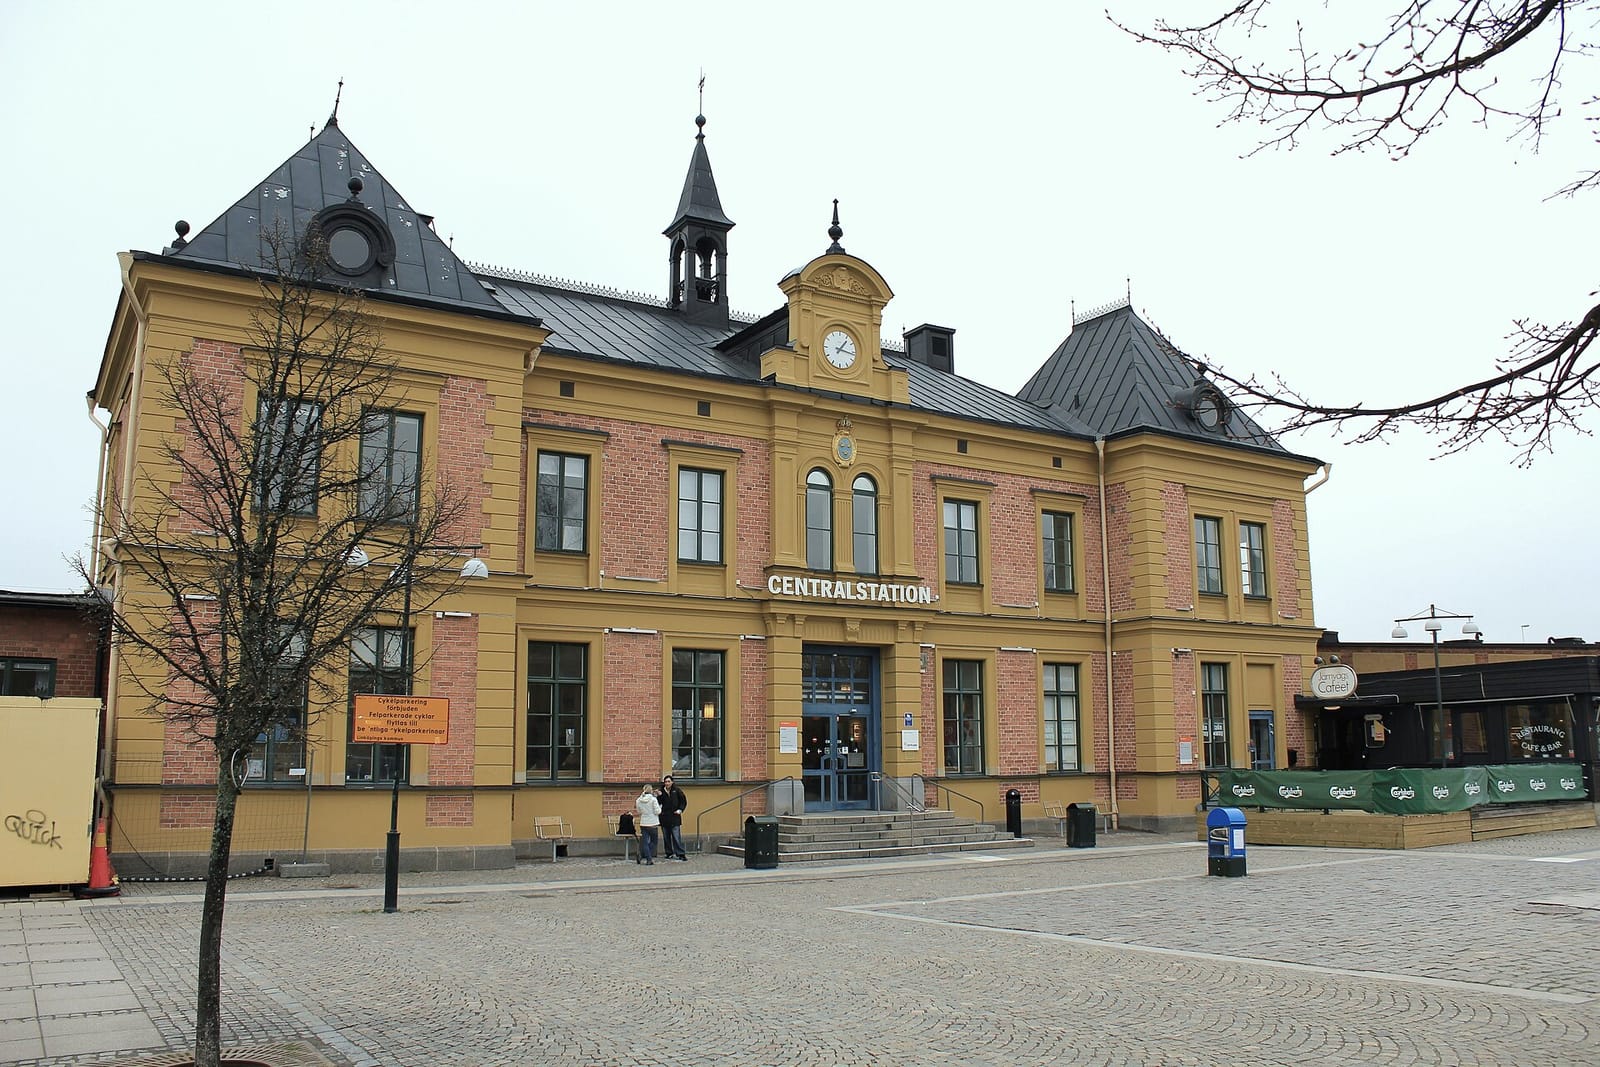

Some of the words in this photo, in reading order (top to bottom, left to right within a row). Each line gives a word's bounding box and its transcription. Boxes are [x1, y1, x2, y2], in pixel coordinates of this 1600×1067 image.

[768, 575, 931, 604] CENTRALSTATION
[378, 698, 428, 706] Cykelparkering
[1515, 725, 1566, 740] RESTAURANG
[1547, 741, 1563, 751] BAR
